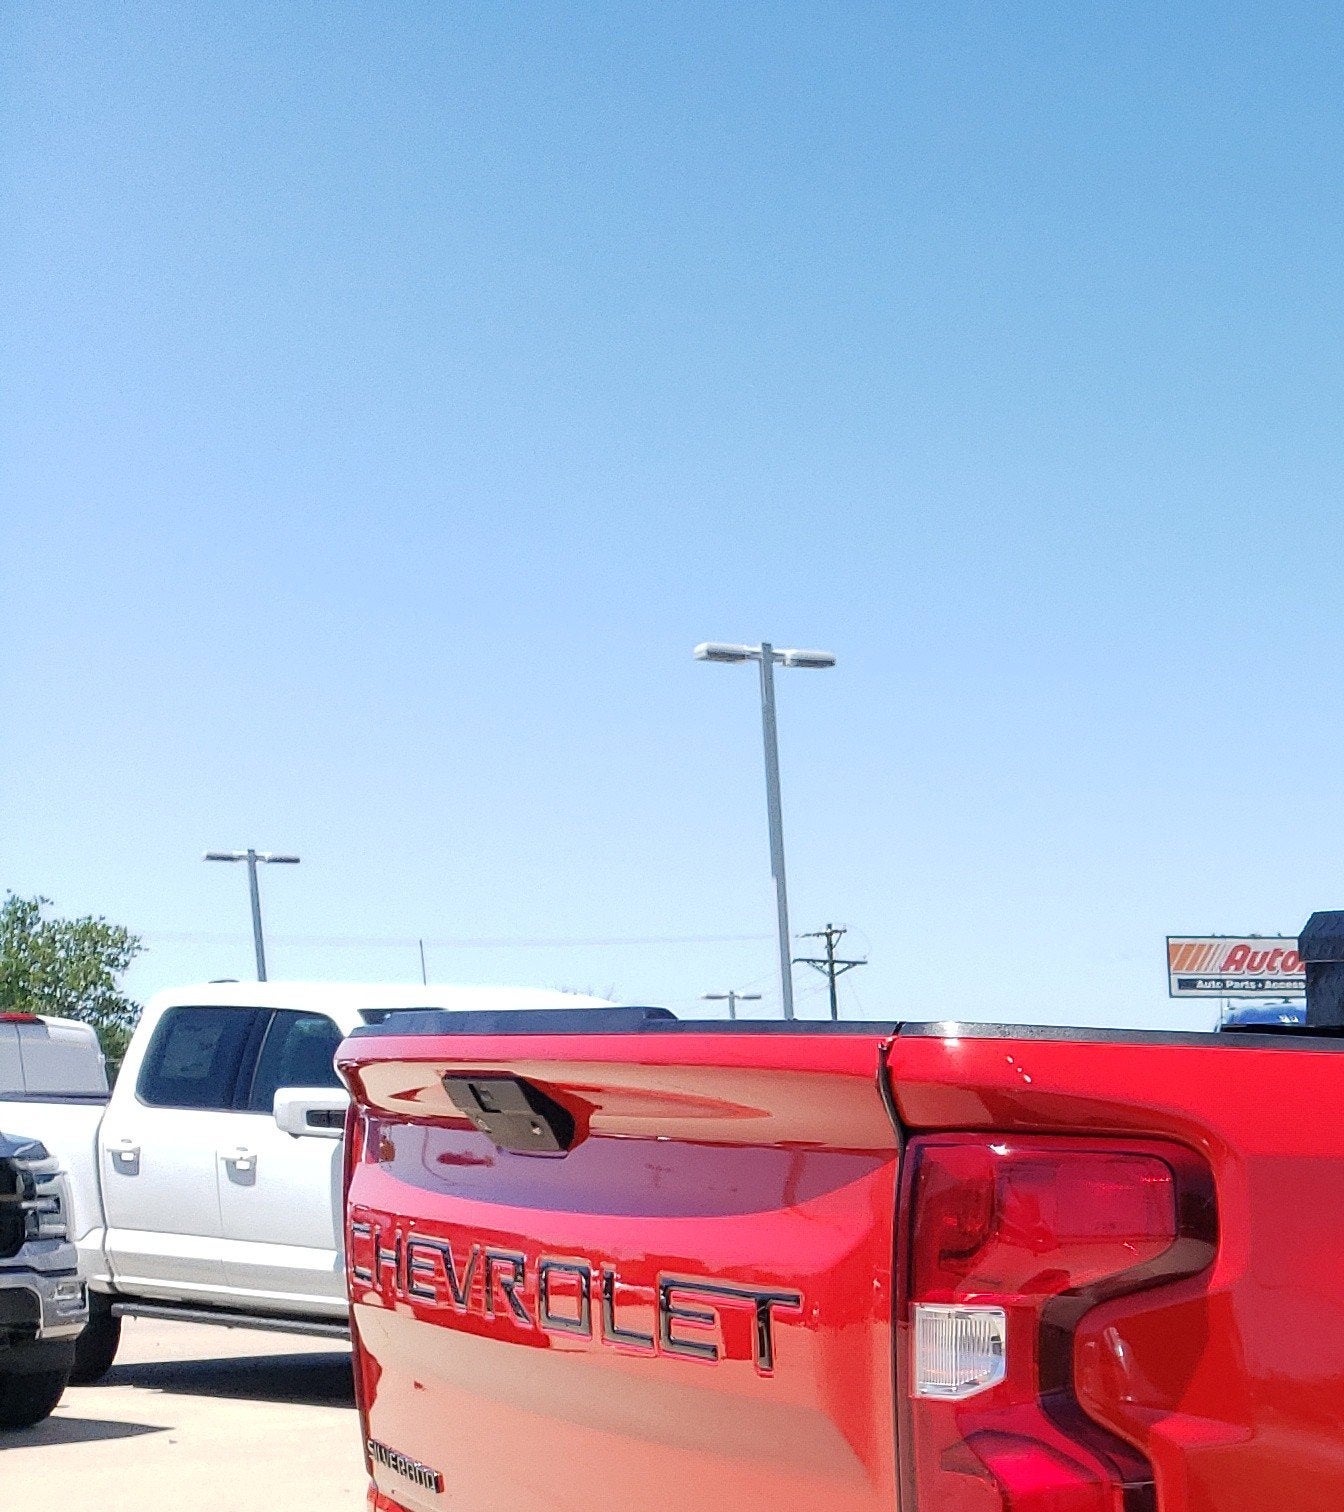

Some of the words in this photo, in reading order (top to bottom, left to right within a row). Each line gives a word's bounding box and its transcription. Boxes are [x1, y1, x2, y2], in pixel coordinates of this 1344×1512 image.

[1219, 944, 1306, 973] Auto
[1196, 979, 1223, 989] Auto
[1225, 980, 1256, 989] Parts
[351, 1216, 805, 1378] CHEVROLET
[367, 1440, 443, 1493] SILVERADO
